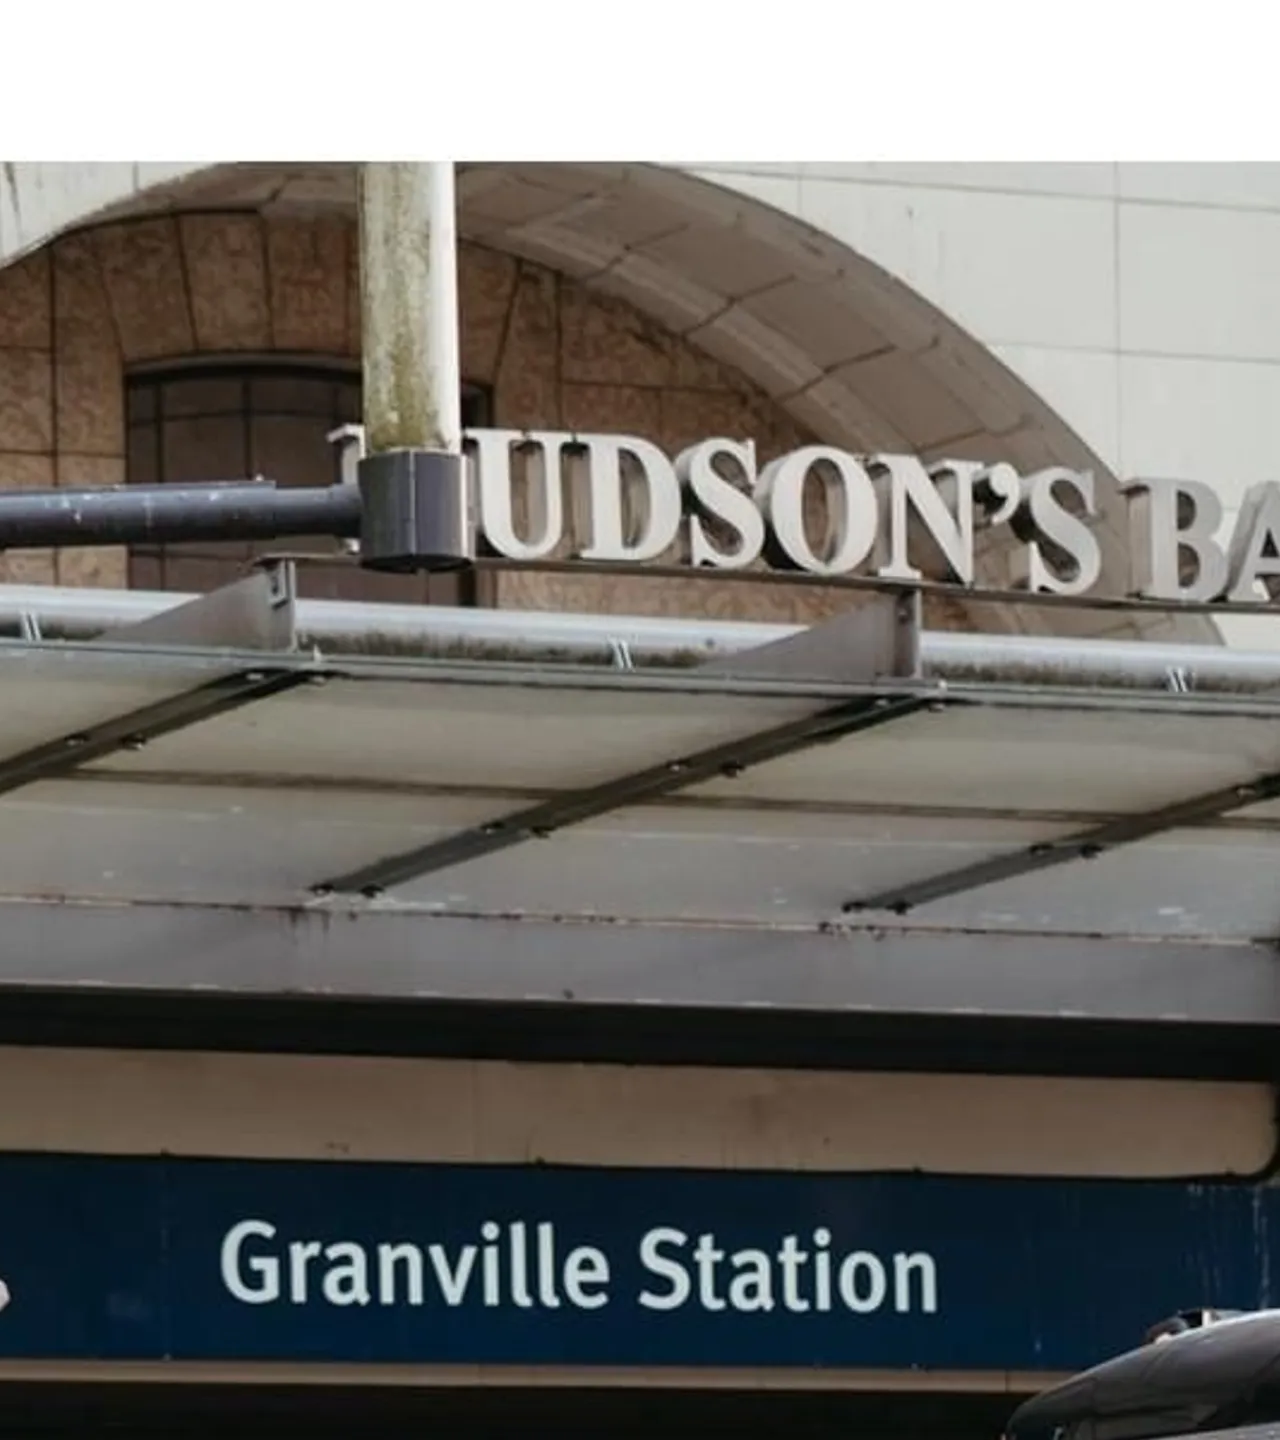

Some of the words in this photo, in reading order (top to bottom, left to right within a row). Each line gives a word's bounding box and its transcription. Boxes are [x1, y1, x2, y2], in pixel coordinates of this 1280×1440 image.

[326, 424, 1102, 594] UDSON'S
[221, 1219, 611, 1307] Granville
[639, 1227, 938, 1314] Station
